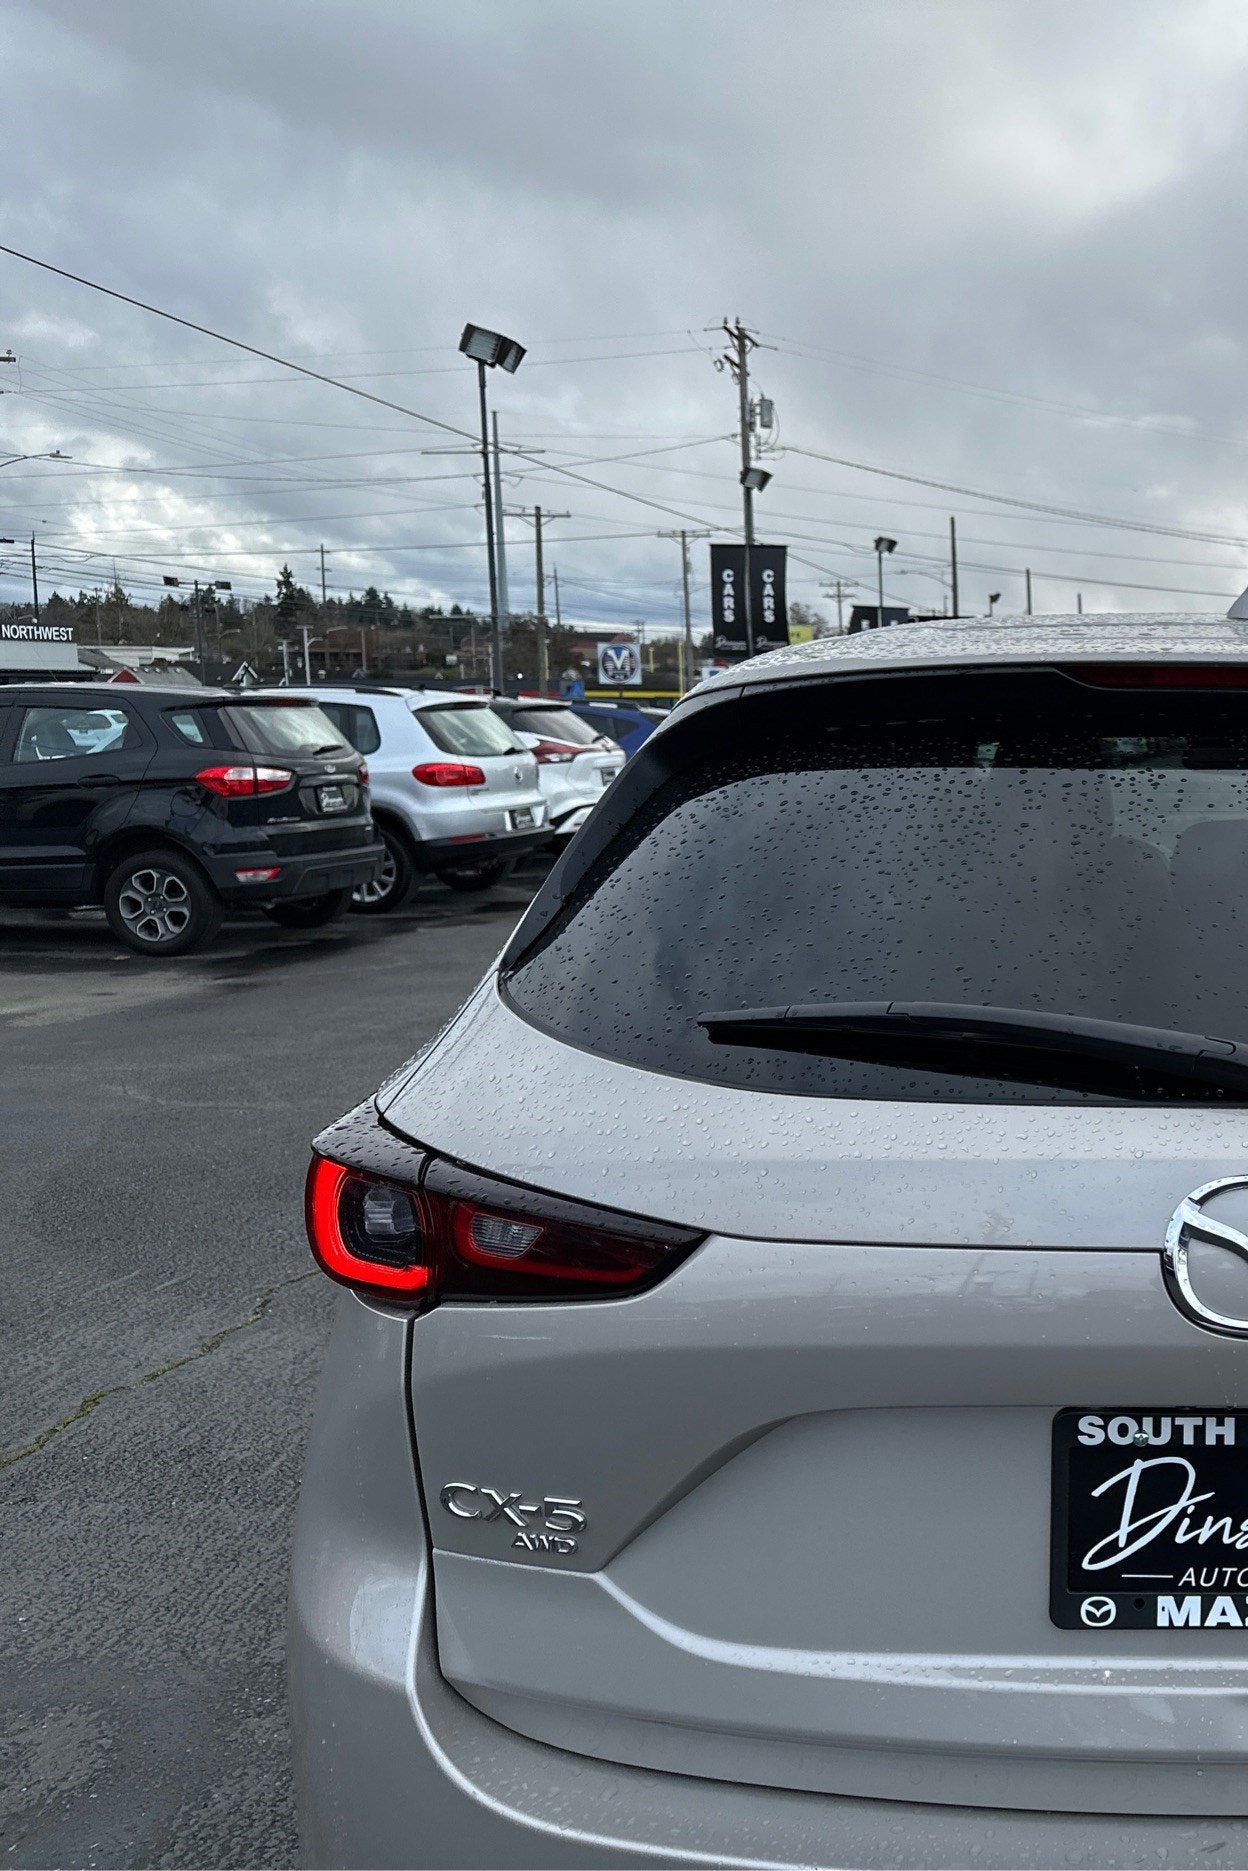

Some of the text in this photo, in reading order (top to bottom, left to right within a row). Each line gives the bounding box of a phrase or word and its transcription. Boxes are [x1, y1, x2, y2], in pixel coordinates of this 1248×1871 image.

[722, 568, 735, 623] CARS
[762, 568, 775, 623] CARS
[1, 624, 74, 641] NORTHWEST
[1077, 1416, 1236, 1447] SOUTH
[440, 1482, 587, 1533] CX-5
[511, 1532, 579, 1555] AWD
